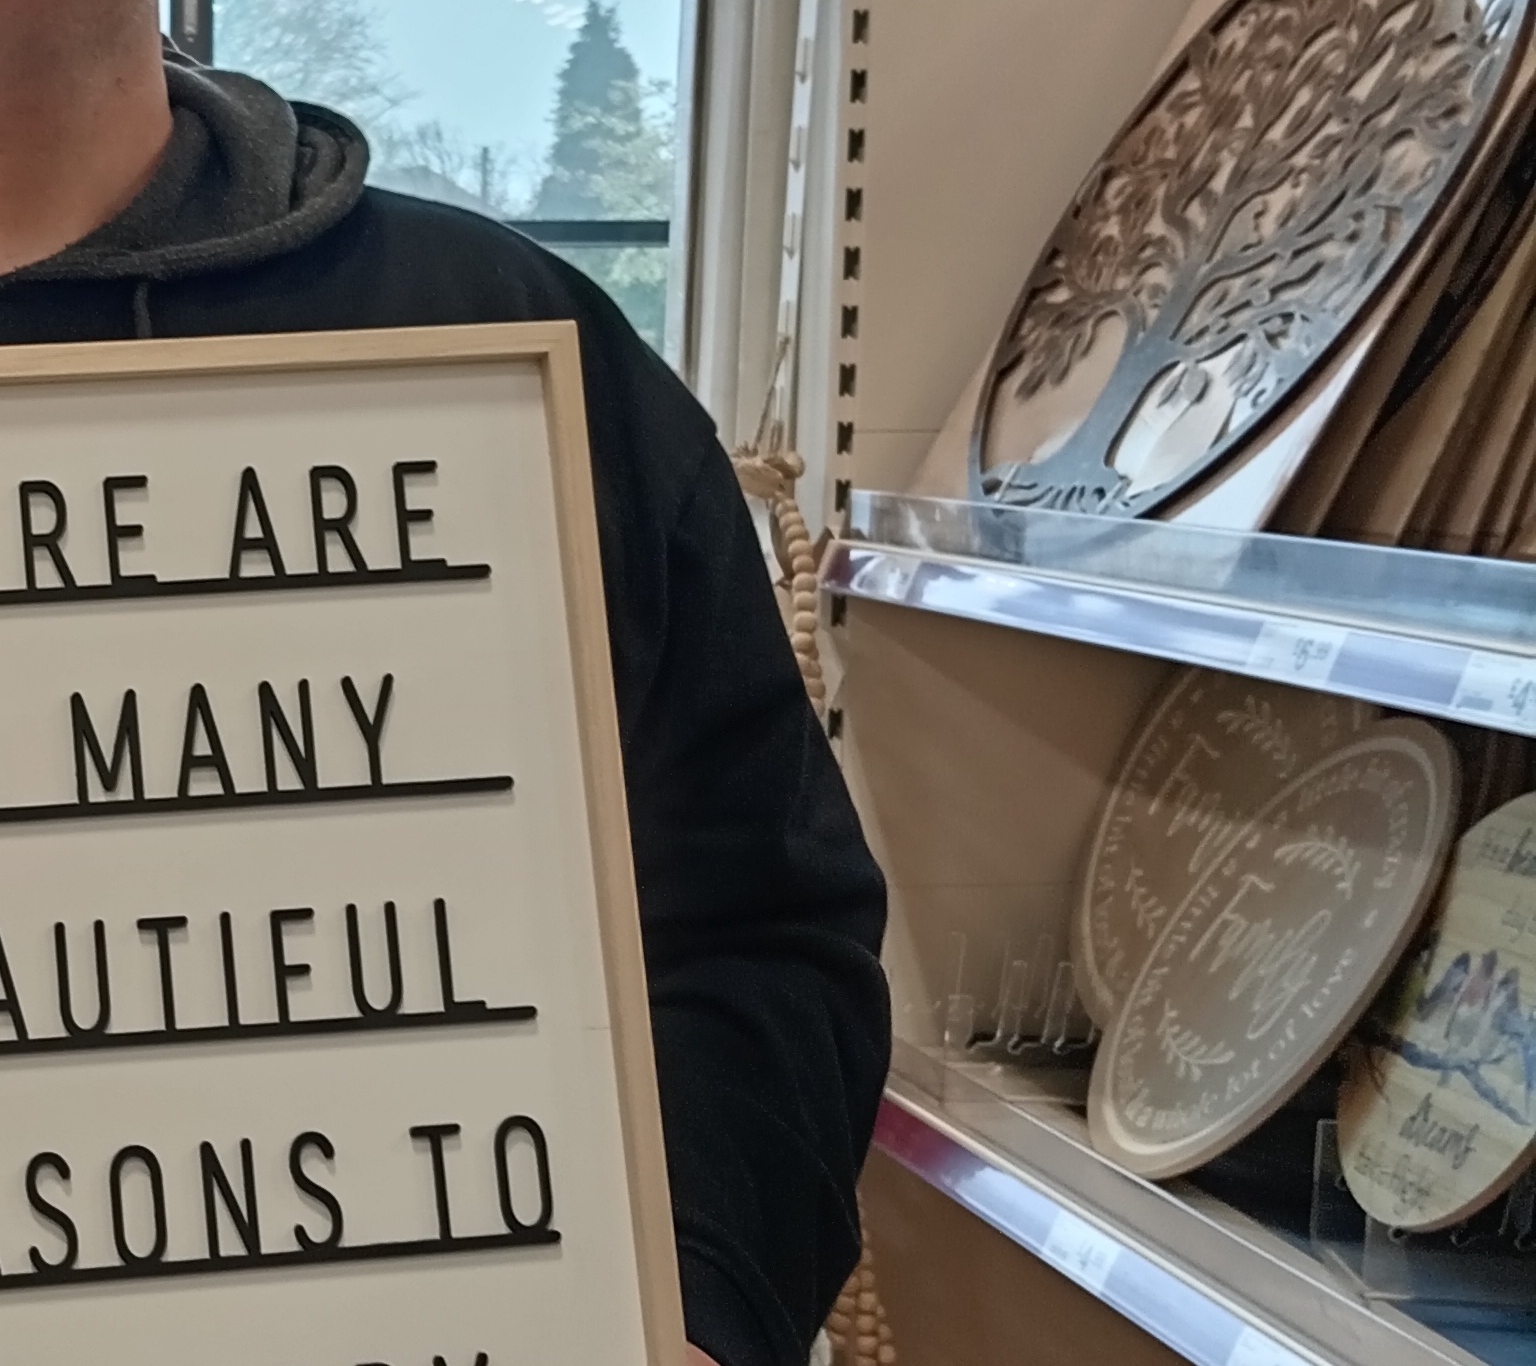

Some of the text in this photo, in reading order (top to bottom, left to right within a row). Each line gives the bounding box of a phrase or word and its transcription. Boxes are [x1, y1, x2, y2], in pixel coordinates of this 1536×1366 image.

[229, 460, 448, 580] ARE
[70, 672, 394, 807] MANY
[409, 1115, 555, 1241] TO
